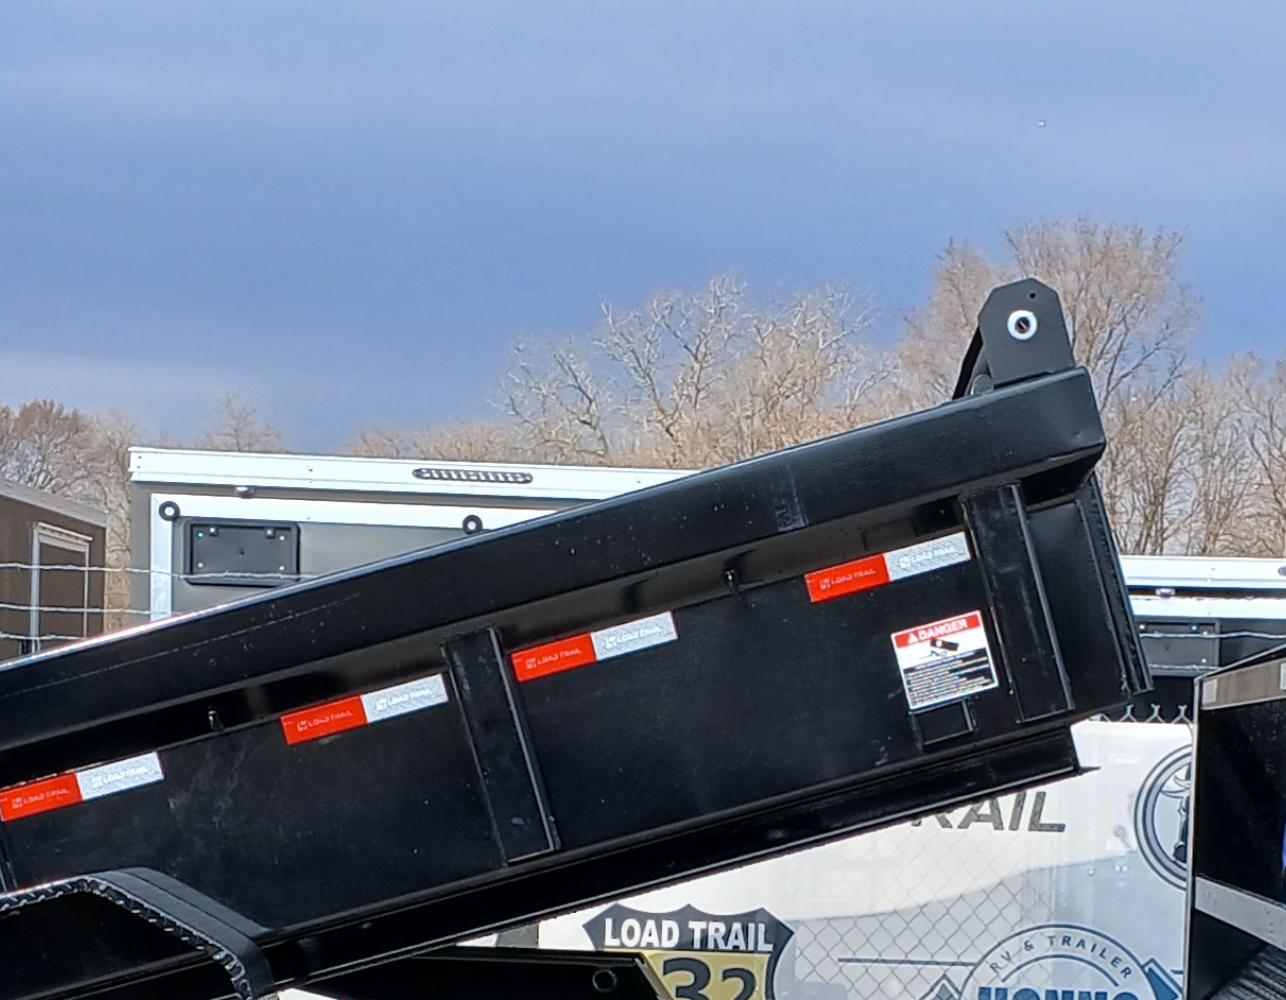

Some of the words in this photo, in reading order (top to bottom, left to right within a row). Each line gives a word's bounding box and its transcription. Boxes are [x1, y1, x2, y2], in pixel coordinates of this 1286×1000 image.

[918, 619, 968, 641] DANGER
[604, 918, 680, 948] LOAD
[688, 921, 773, 952] TRAIL
[989, 951, 1013, 974] RV
[1024, 940, 1035, 951] &
[1047, 935, 1133, 978] TRAILER
